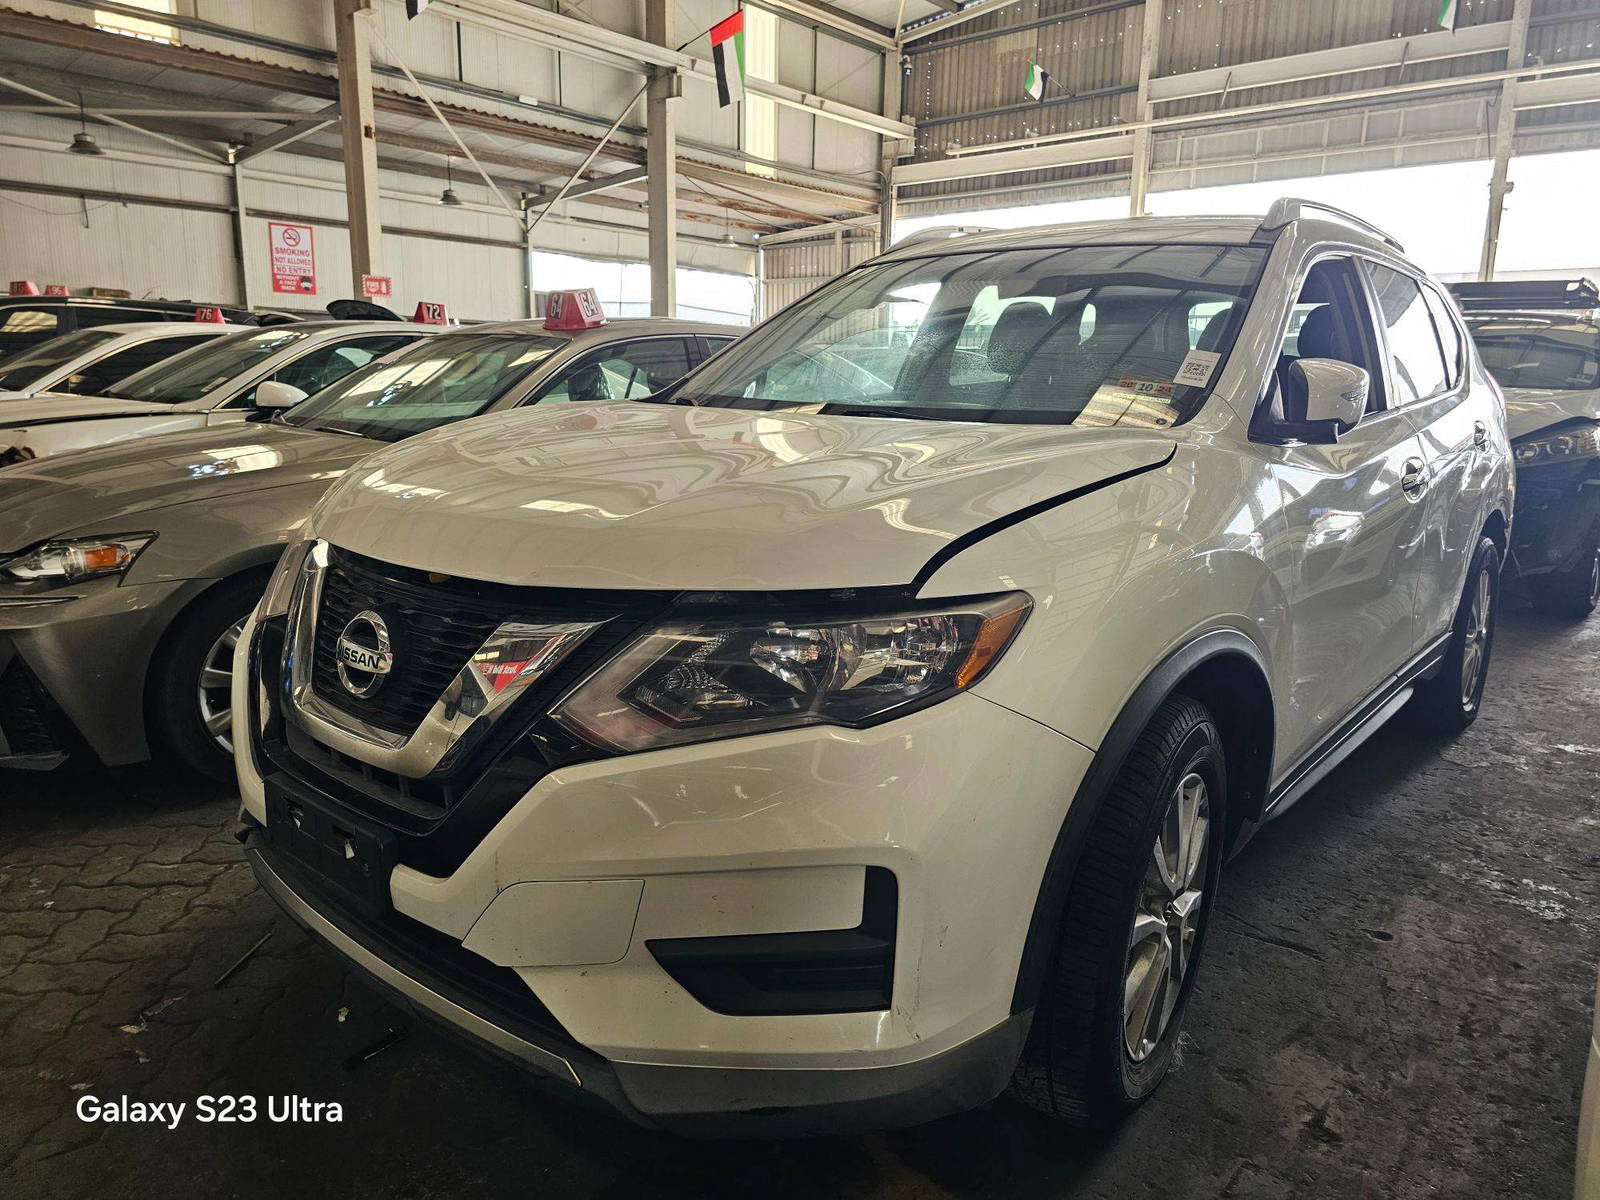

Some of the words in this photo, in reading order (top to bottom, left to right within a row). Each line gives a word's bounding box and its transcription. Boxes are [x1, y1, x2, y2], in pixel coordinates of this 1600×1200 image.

[275, 247, 310, 257] SMOKING
[287, 258, 311, 266] ALLOWED
[289, 267, 311, 275] ENTRY
[551, 293, 563, 319] 64
[580, 291, 599, 317] 64
[201, 308, 212, 320] 76
[426, 304, 441, 320] 72
[1138, 382, 1154, 392] 10
